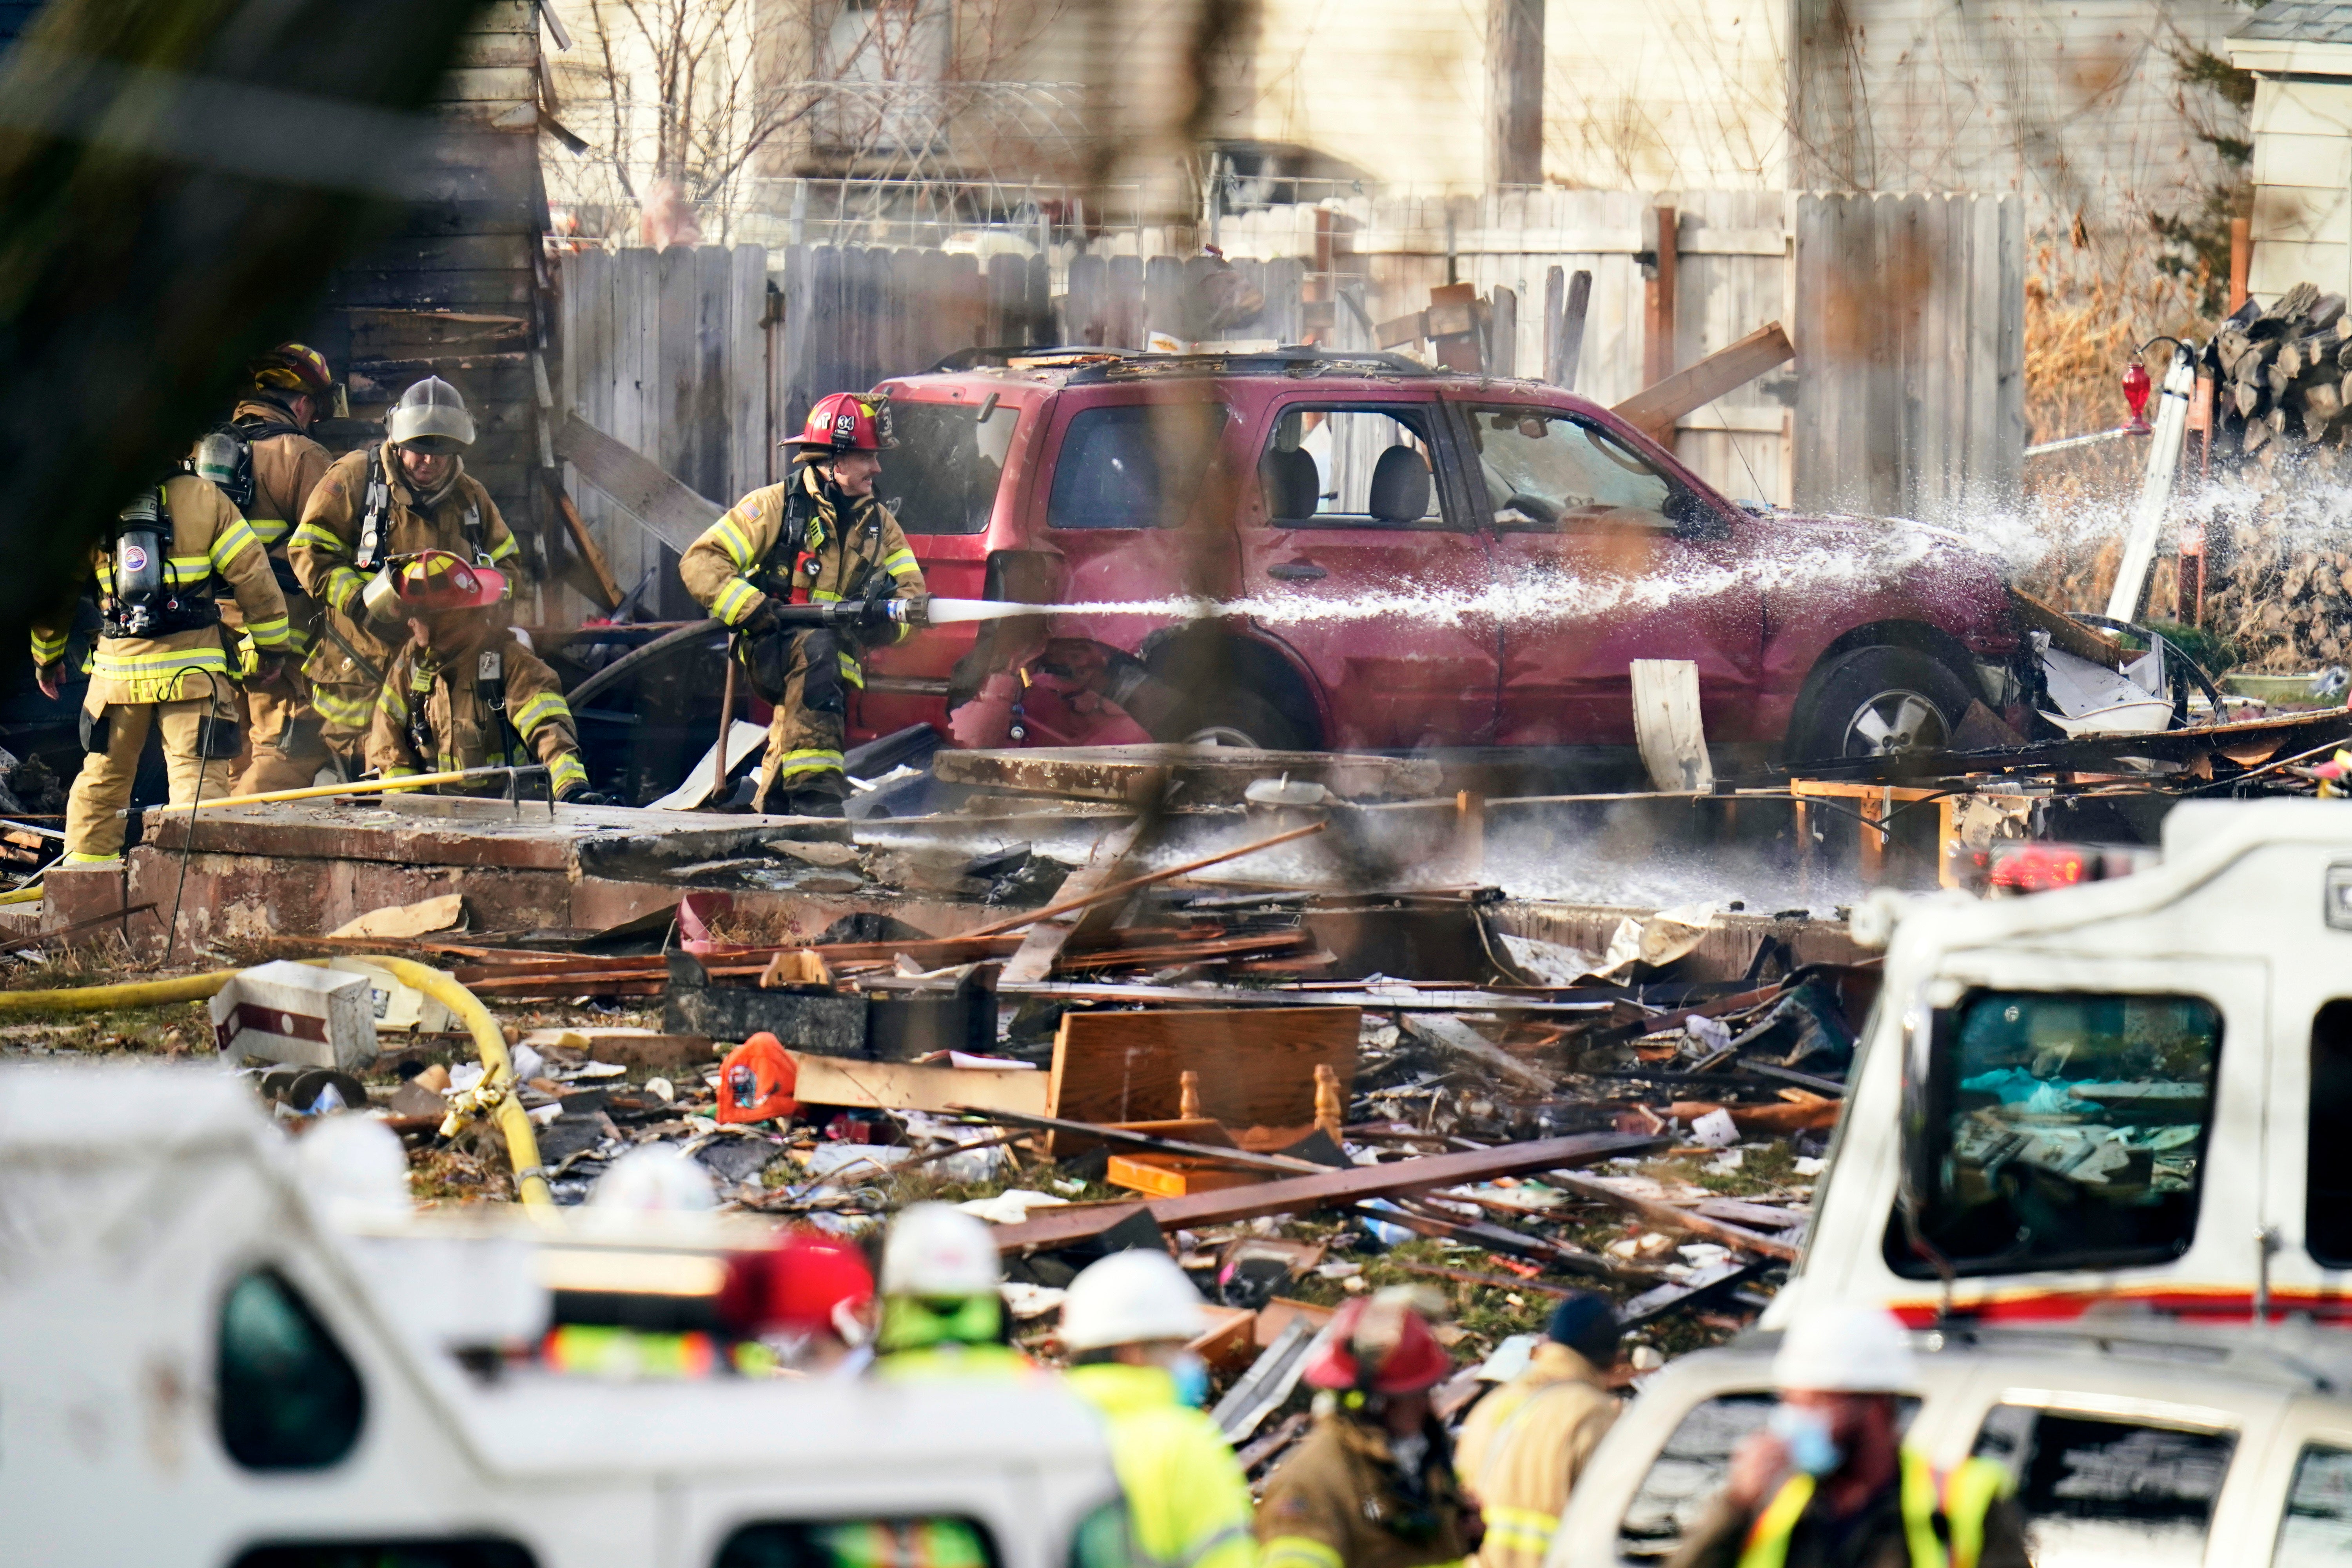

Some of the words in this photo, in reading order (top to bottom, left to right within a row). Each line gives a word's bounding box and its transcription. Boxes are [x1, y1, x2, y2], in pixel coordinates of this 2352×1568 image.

[822, 412, 831, 429] T
[838, 415, 854, 430] 34
[129, 675, 184, 703] HENRY
